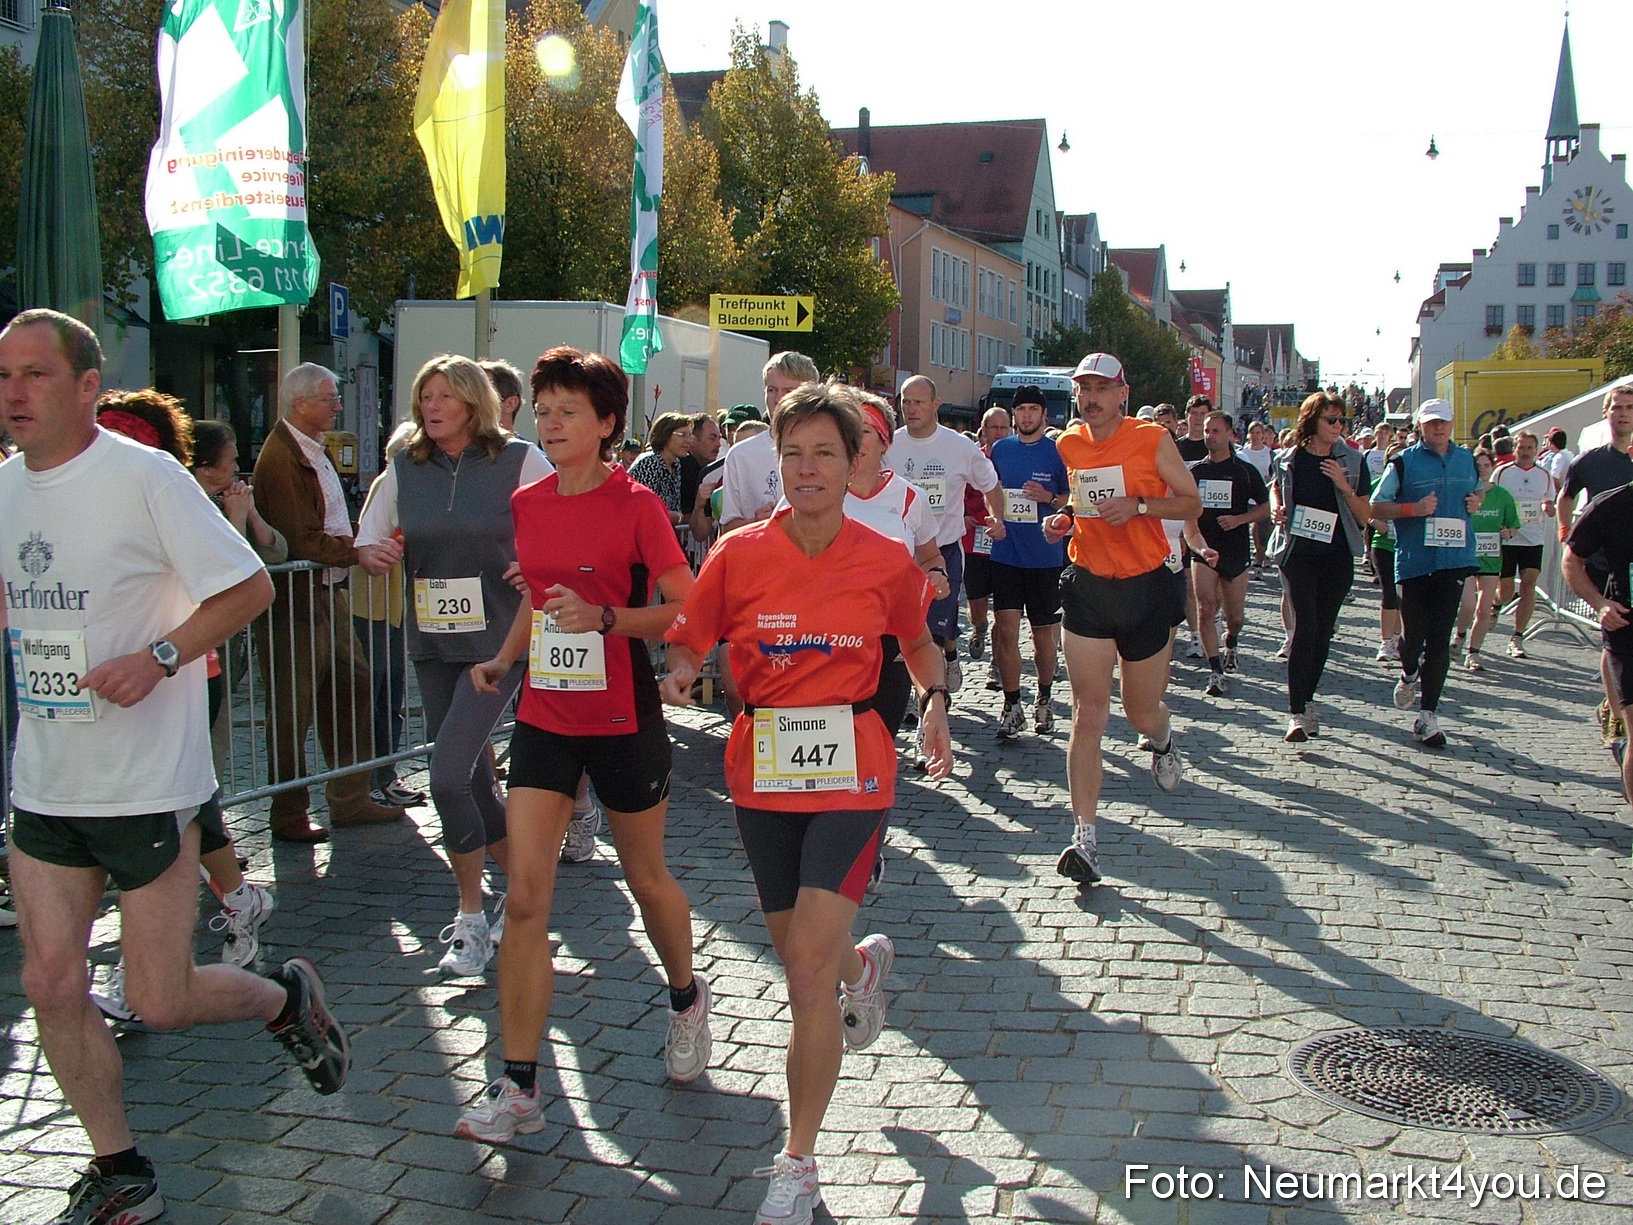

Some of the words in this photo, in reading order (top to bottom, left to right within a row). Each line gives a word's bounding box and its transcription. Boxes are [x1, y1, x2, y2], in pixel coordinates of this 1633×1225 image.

[334, 291, 345, 330] P
[718, 298, 786, 312] Treffpunkt
[718, 314, 789, 328] Bladenight
[363, 369, 372, 470] INDIGO
[1079, 474, 1098, 484] Hans
[1088, 488, 1115, 503] 957
[1207, 492, 1229, 501] 3605
[1012, 503, 1031, 514] 234
[1524, 510, 1537, 518] 790
[1304, 518, 1331, 533] 3599
[1436, 528, 1462, 539] 3598
[429, 578, 447, 589] Gabi
[437, 597, 471, 615] 230
[757, 613, 797, 622] Regensburg
[757, 620, 797, 629] Marathon
[775, 634, 797, 647] 28.
[800, 633, 828, 646] Mai
[829, 635, 864, 648] 2006
[22, 638, 71, 660] Wolfgang
[550, 646, 589, 669] 807
[29, 670, 82, 697] 2333
[568, 678, 605, 687] PFLEIDERER
[56, 707, 92, 717] PFLEIDERER
[778, 716, 827, 732] Simone
[758, 741, 765, 753] C
[791, 743, 839, 768] 447
[816, 775, 856, 785] PFLEIDERER
